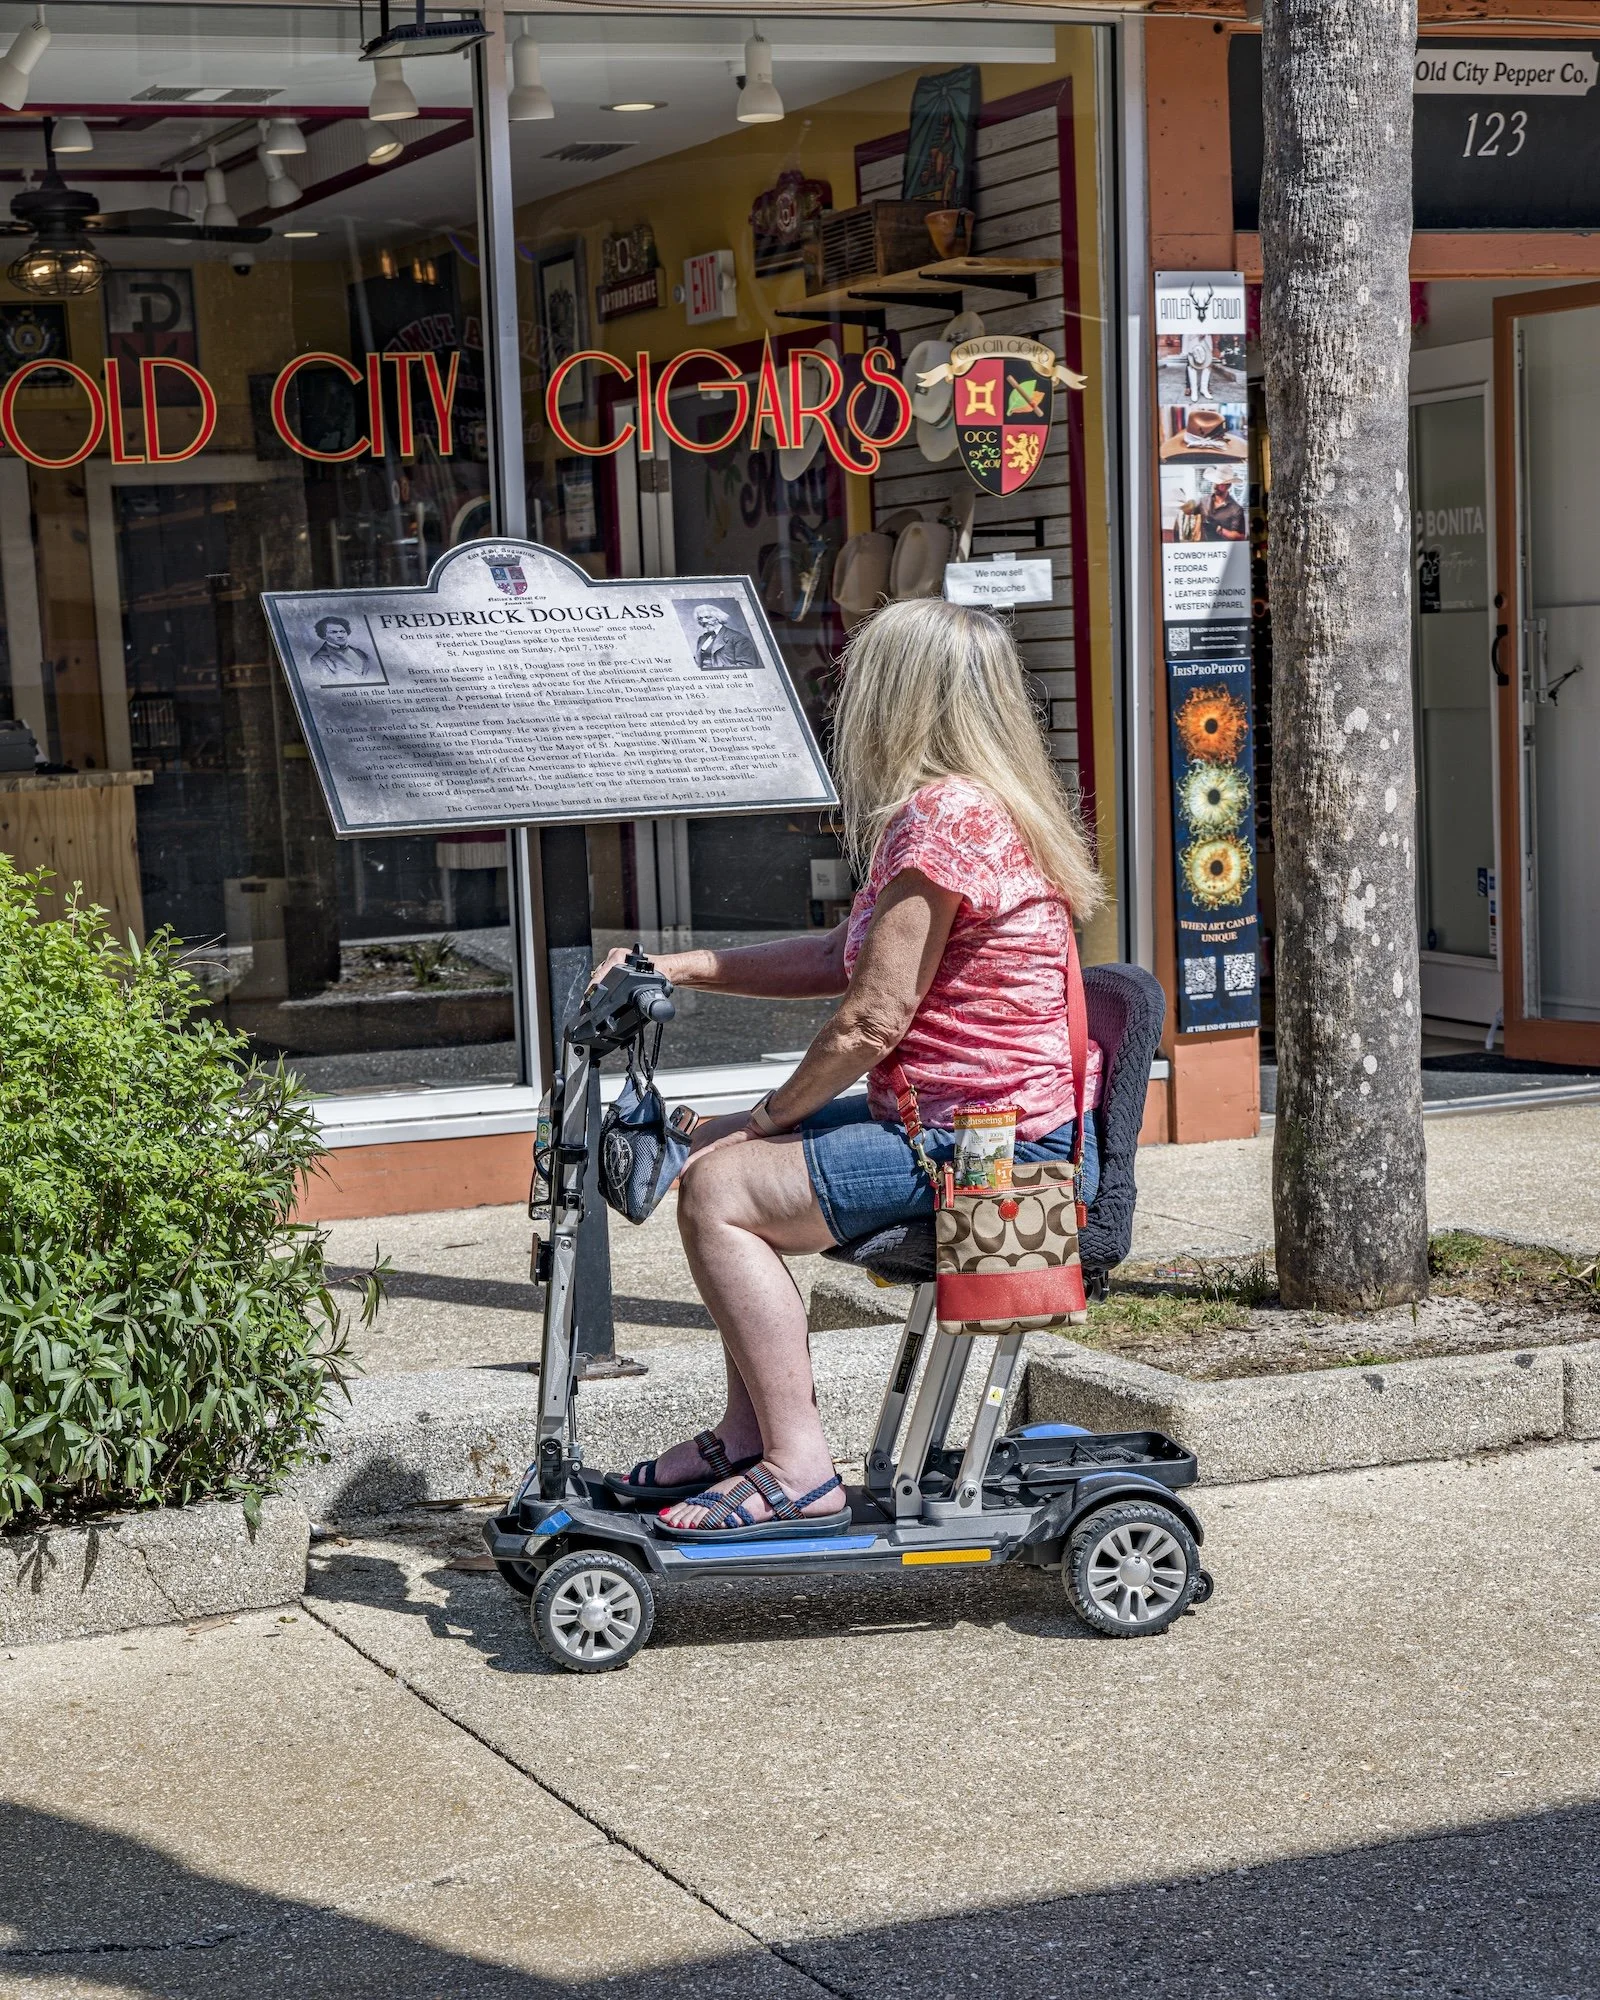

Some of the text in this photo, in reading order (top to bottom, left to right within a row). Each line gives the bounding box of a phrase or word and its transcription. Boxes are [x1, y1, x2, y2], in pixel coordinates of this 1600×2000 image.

[1415, 61, 1588, 86] Old City Pepper Co.
[1462, 110, 1528, 158] 123
[691, 255, 716, 315] EXIT
[1161, 298, 1241, 319] ANTLER CROWN
[0, 329, 912, 475] OLD CITY CIGARS
[964, 430, 998, 443] OCC
[1426, 505, 1485, 537] BONITA
[1174, 551, 1228, 560] COWBOY HATS
[975, 570, 989, 578] We
[1009, 568, 1023, 576] sell
[1174, 564, 1208, 572] FEDORAS
[1174, 576, 1221, 585] RE-SHAPING
[973, 584, 1026, 593] ZYN pouches
[1175, 588, 1246, 598] LEATHER BRANDING
[1175, 601, 1245, 610] WESTERN APPAREL
[380, 604, 664, 628] FREDERICK DOUGLASS
[416, 632, 433, 640] this
[544, 627, 571, 635] Opera
[436, 640, 478, 648] Frederick
[480, 638, 521, 646] Douglass
[523, 637, 547, 645] spoke
[462, 649, 506, 657] Augustine
[558, 644, 580, 653] April
[524, 662, 565, 670] Douglass
[613, 658, 653, 667] pre-Civil
[494, 672, 527, 680] leading
[529, 671, 569, 679] exponent
[406, 685, 453, 694] nineteenth
[604, 676, 681, 684] African-American
[341, 699, 362, 707] civil
[364, 697, 401, 705] liberties
[465, 692, 502, 702] personal
[504, 691, 531, 699] friend
[624, 685, 665, 693] Douglass
[666, 683, 695, 693] played
[726, 681, 743, 689] role
[390, 705, 440, 715] persuading
[457, 702, 499, 710] President
[553, 698, 613, 706] Emancipation
[614, 695, 672, 703] Proclamation
[1180, 914, 1257, 930] WHEN ART CAN BE
[1201, 931, 1238, 943] UNIQUE
